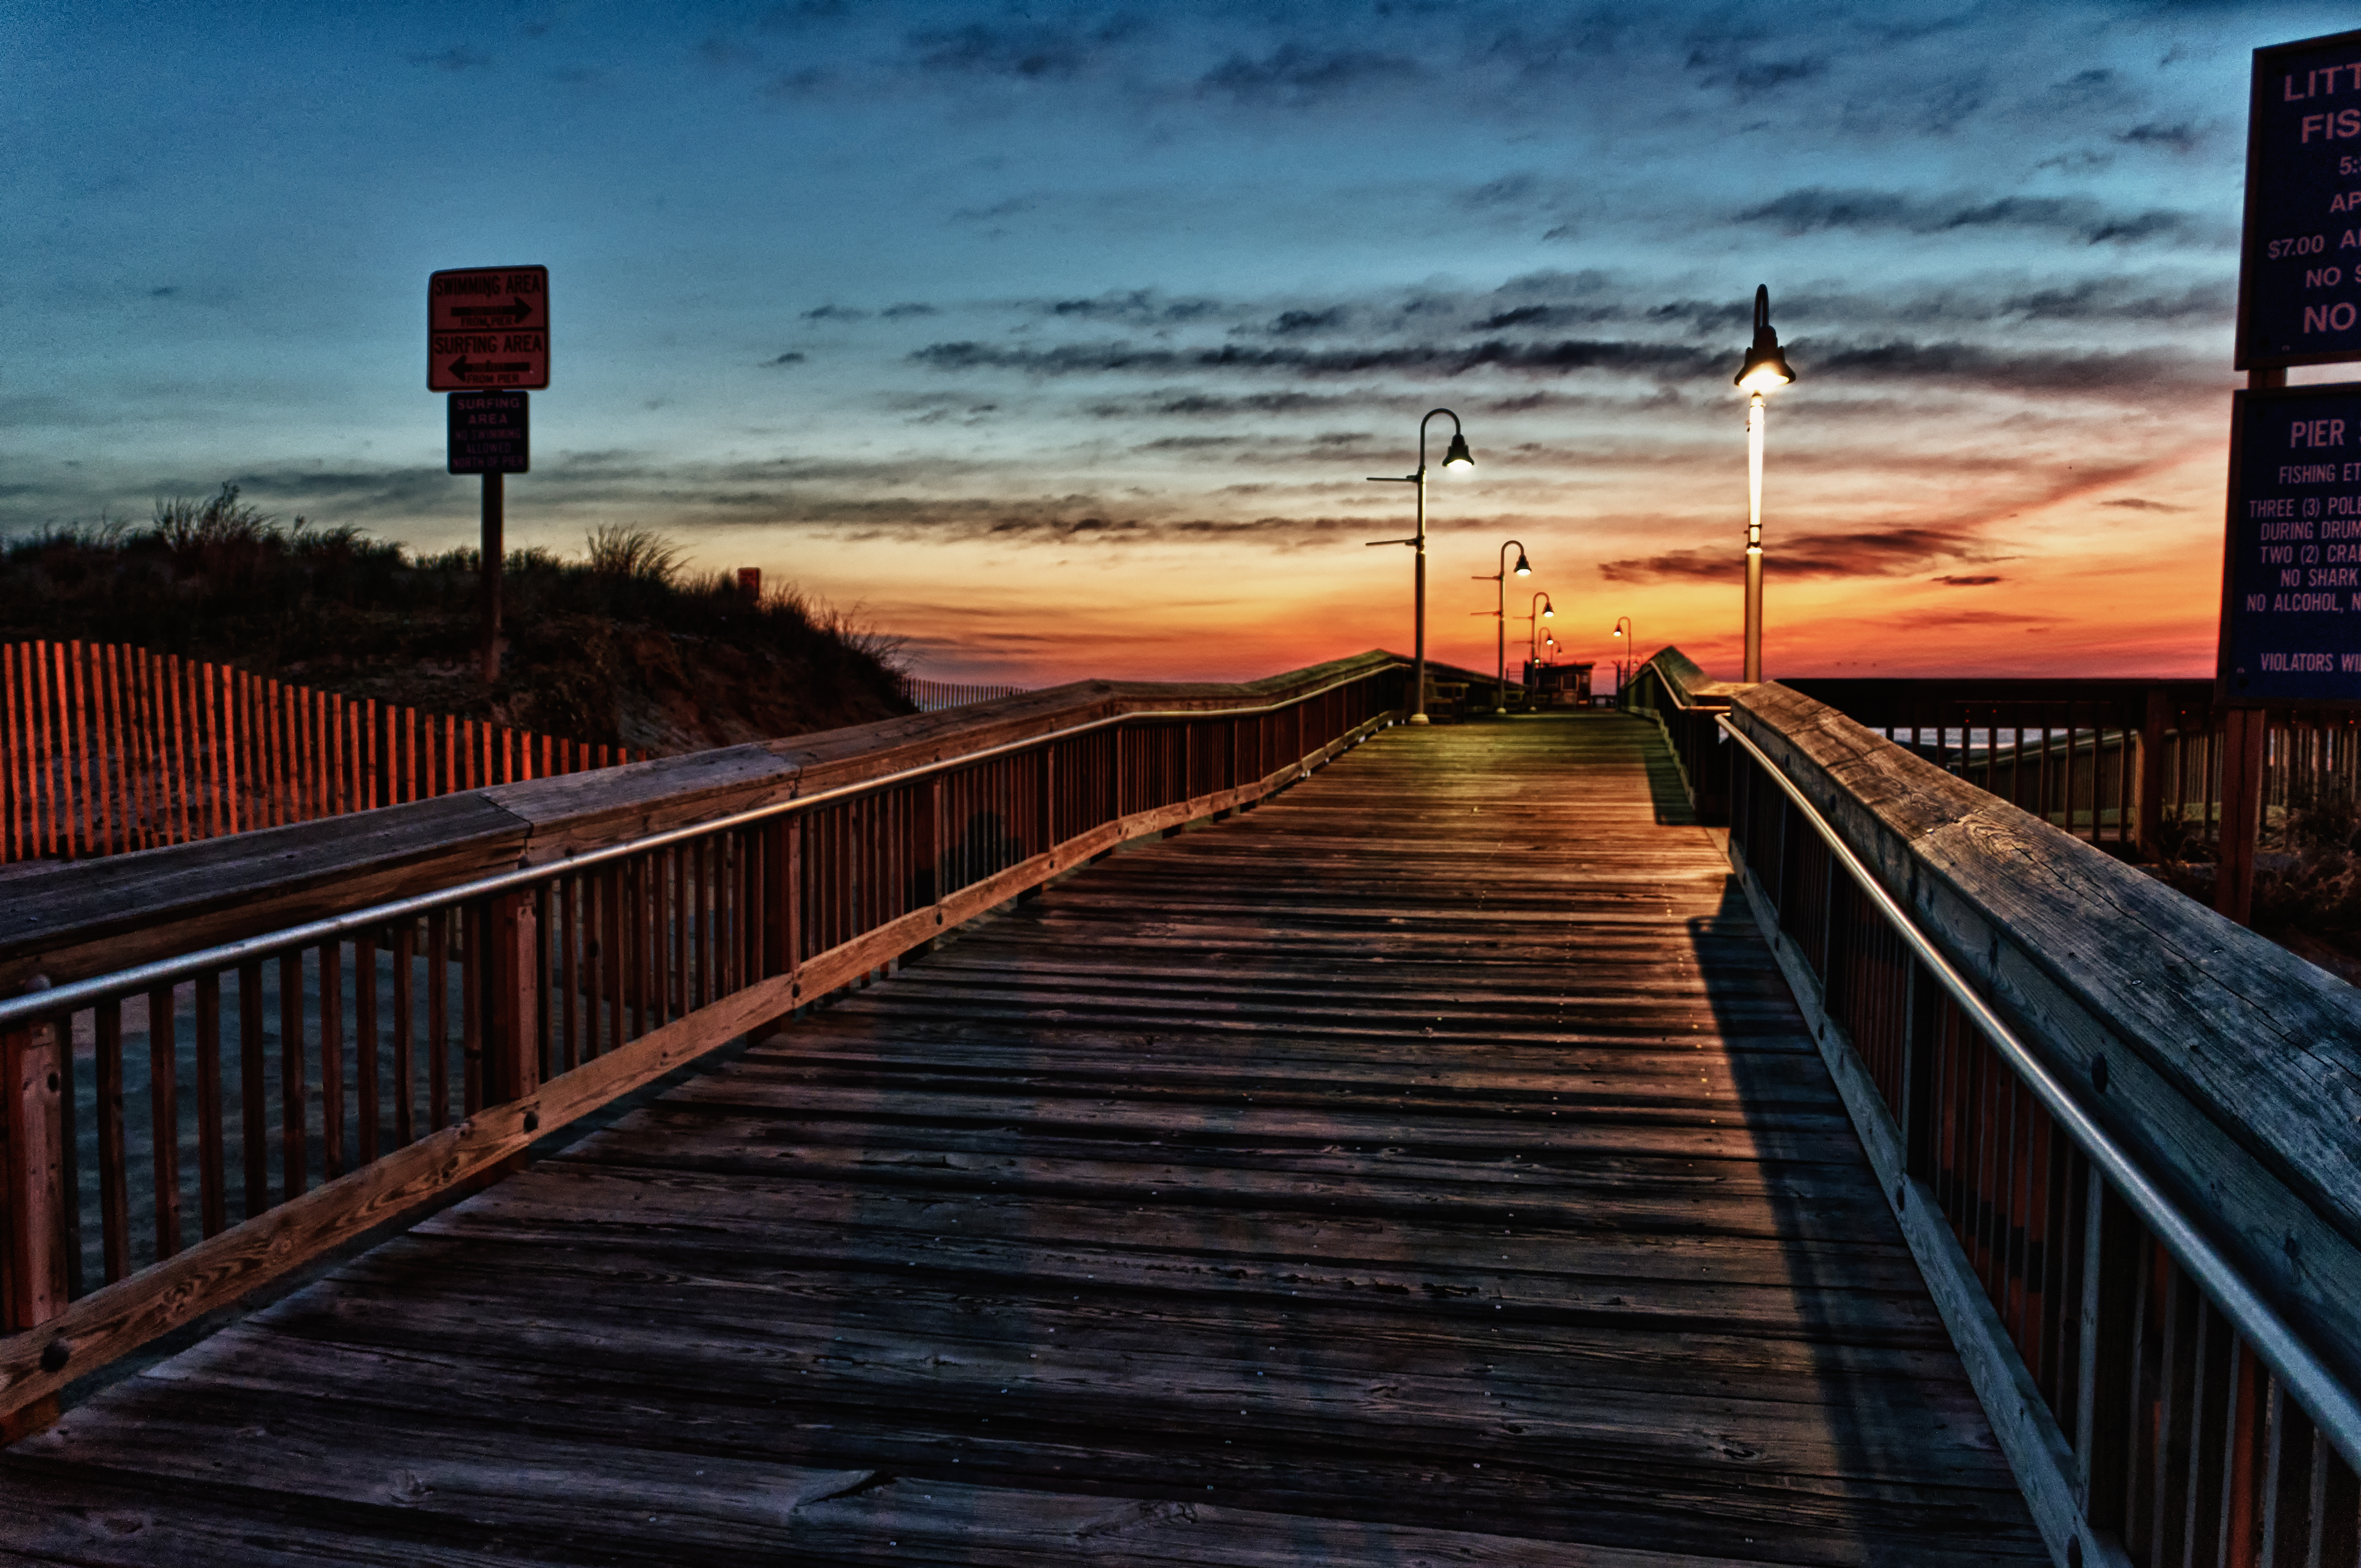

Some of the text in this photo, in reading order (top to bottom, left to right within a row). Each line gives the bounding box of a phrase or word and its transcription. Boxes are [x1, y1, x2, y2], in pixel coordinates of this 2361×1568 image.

[2339, 155, 2361, 176] 5:
[2267, 234, 2325, 260] $7.00
[435, 274, 541, 296] SWIMMING AREA
[2305, 267, 2342, 288] NO
[460, 316, 512, 326] FROM PIER
[2303, 302, 2356, 334] NO
[435, 335, 542, 354] SURFING AREA
[467, 374, 520, 384] FROM PIER
[456, 397, 520, 410] SURFING
[468, 413, 508, 424] AREA
[455, 428, 521, 440] NO SWIMMING
[2290, 419, 2345, 448] PIER
[466, 442, 511, 454] ALLOWED
[453, 455, 524, 468] NORTH OF PIER
[2279, 464, 2336, 484] FISHING
[2249, 498, 2294, 519] THREE
[2302, 497, 2320, 519] (3)
[2260, 521, 2313, 541] DURING
[2260, 546, 2293, 565] TWO
[2300, 545, 2320, 565] (2)
[2281, 568, 2359, 587] NO SHARK
[2246, 594, 2266, 612] NO
[2273, 592, 2344, 613] ALCOHOL,
[2260, 652, 2333, 672] VIOLATORS
